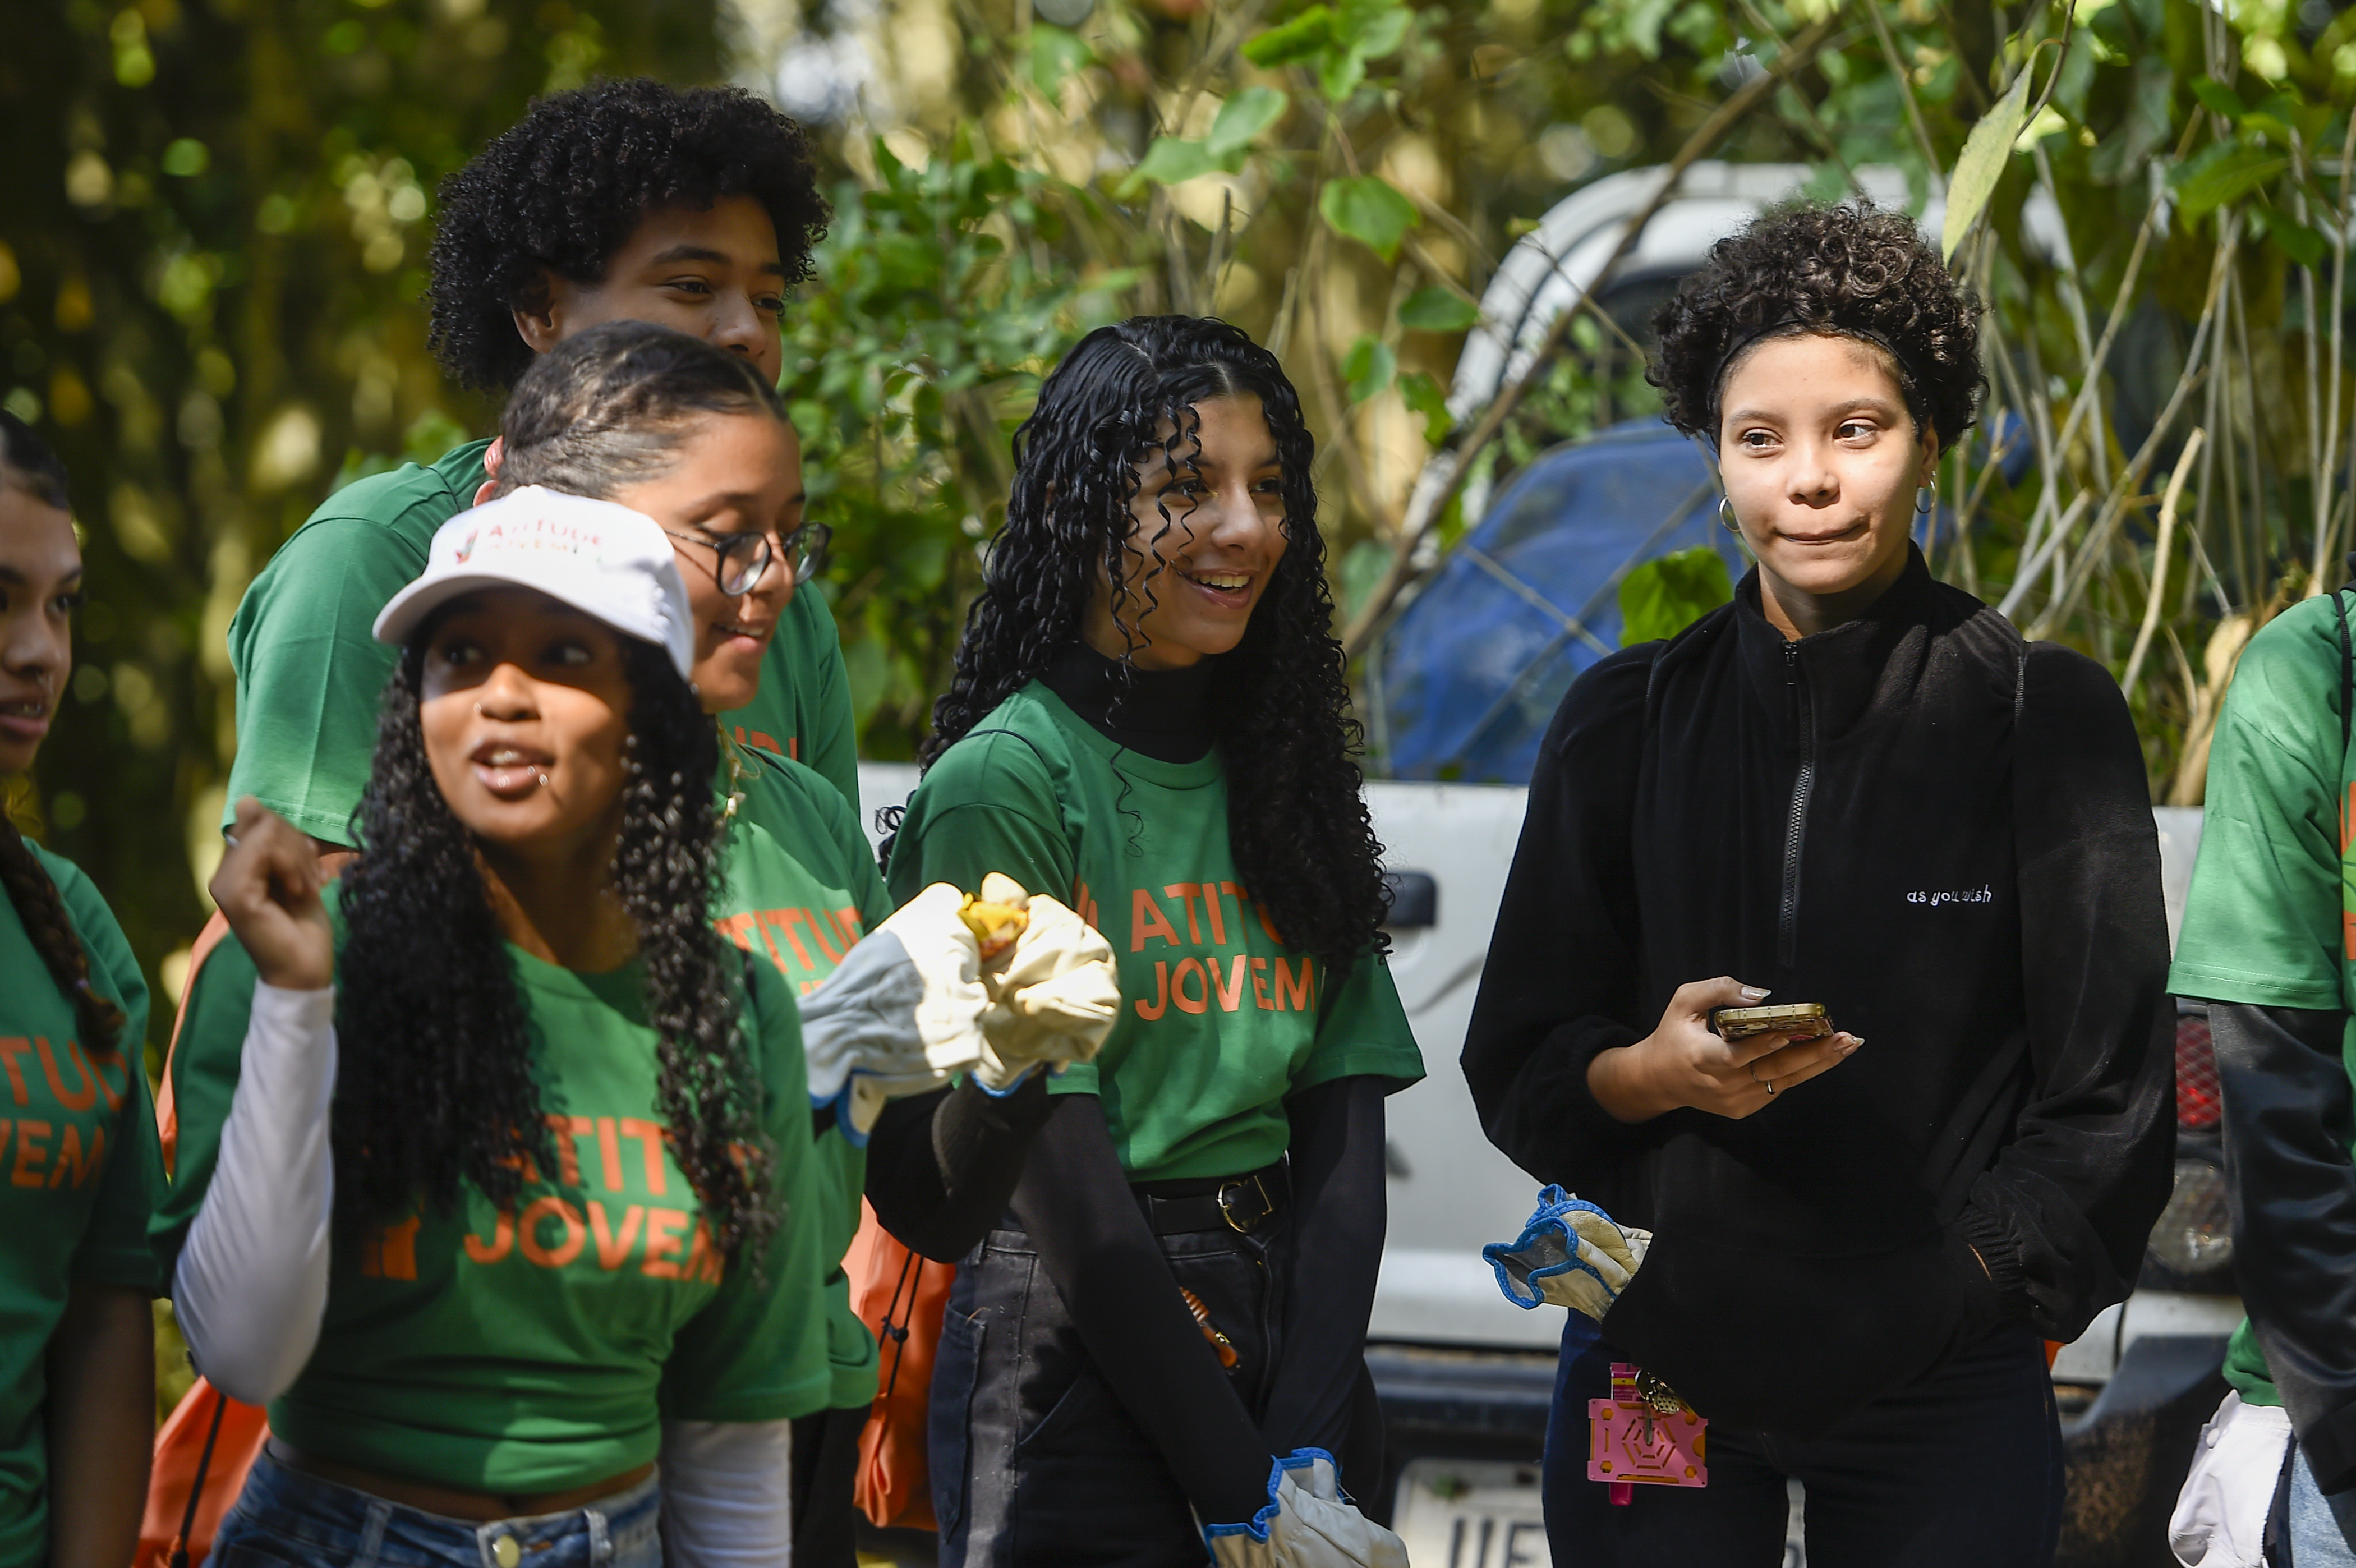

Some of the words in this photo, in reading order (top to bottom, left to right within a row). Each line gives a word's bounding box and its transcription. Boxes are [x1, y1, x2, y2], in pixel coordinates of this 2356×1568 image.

[1907, 890, 1927, 903] as
[1930, 891, 1960, 907] you
[1962, 884, 1992, 903] wish
[1134, 954, 1315, 1021] JOVEM
